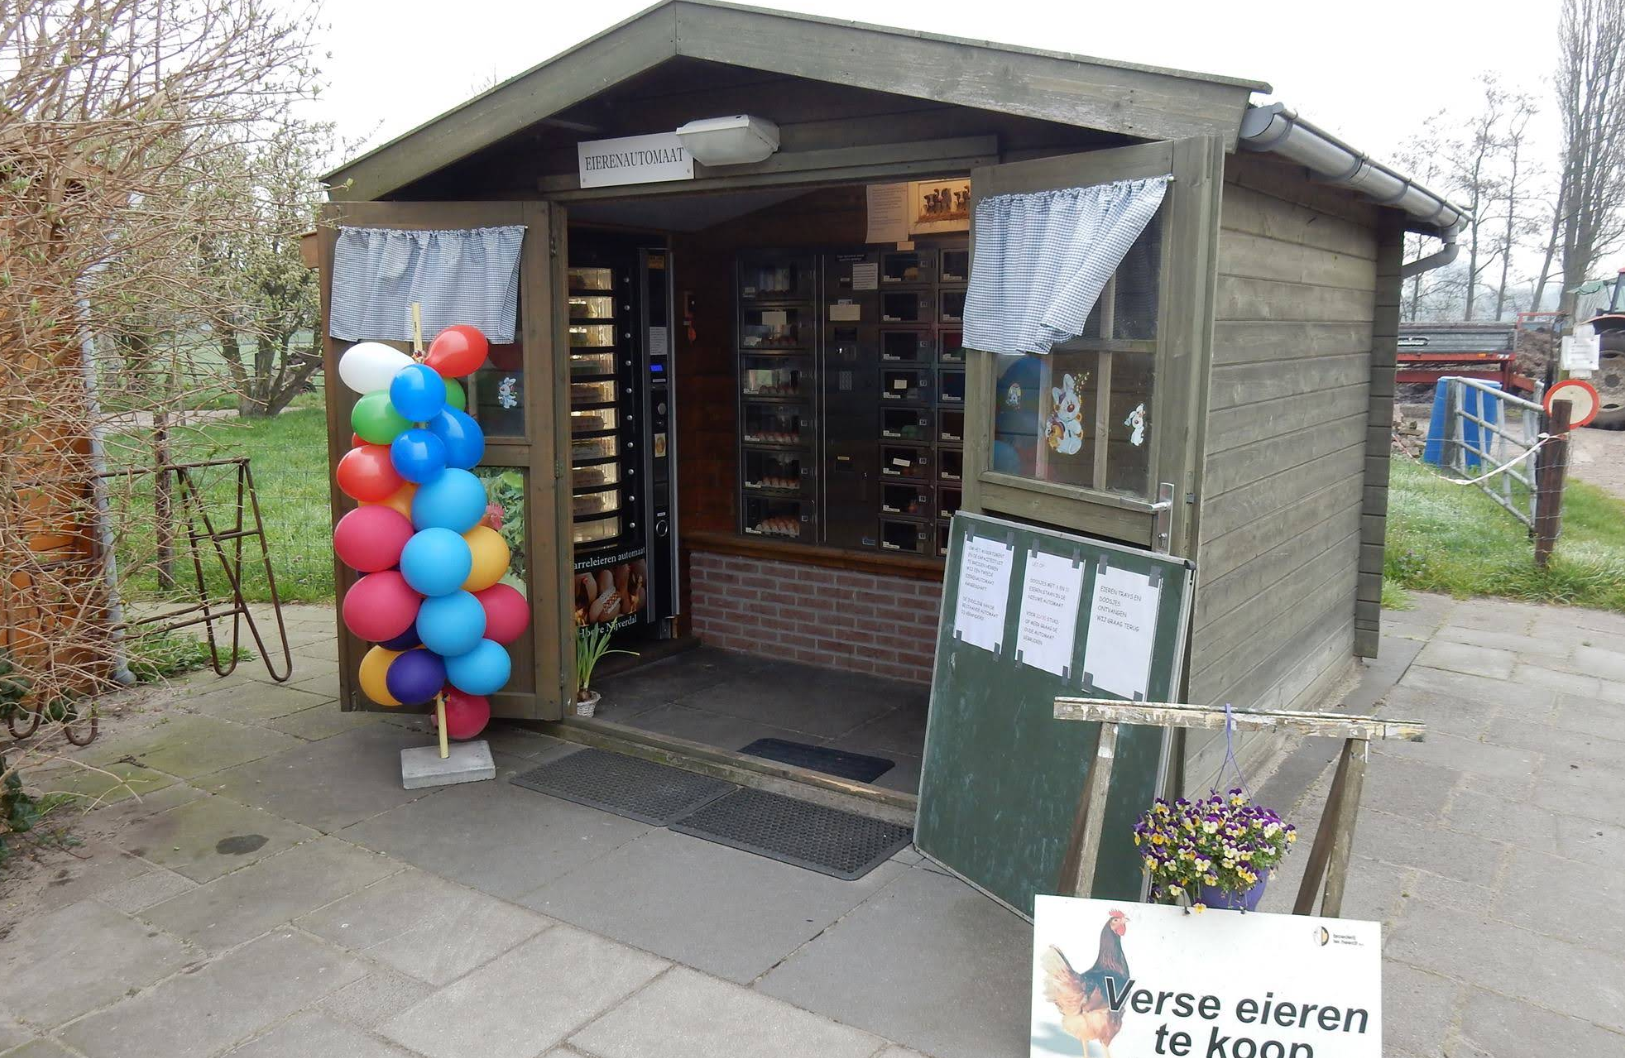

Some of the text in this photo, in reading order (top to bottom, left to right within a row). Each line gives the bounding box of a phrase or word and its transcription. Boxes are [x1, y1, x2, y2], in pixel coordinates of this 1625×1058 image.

[585, 147, 685, 171] EIERENAUTOMAAT
[574, 556, 617, 569] arreleieren
[1100, 585, 1118, 595] EIEREN
[1099, 596, 1121, 606] DOOSJES
[1097, 605, 1127, 618] ONTVANGEN
[1104, 976, 1369, 1034] Verse eieren
[1155, 1023, 1192, 1057] te
